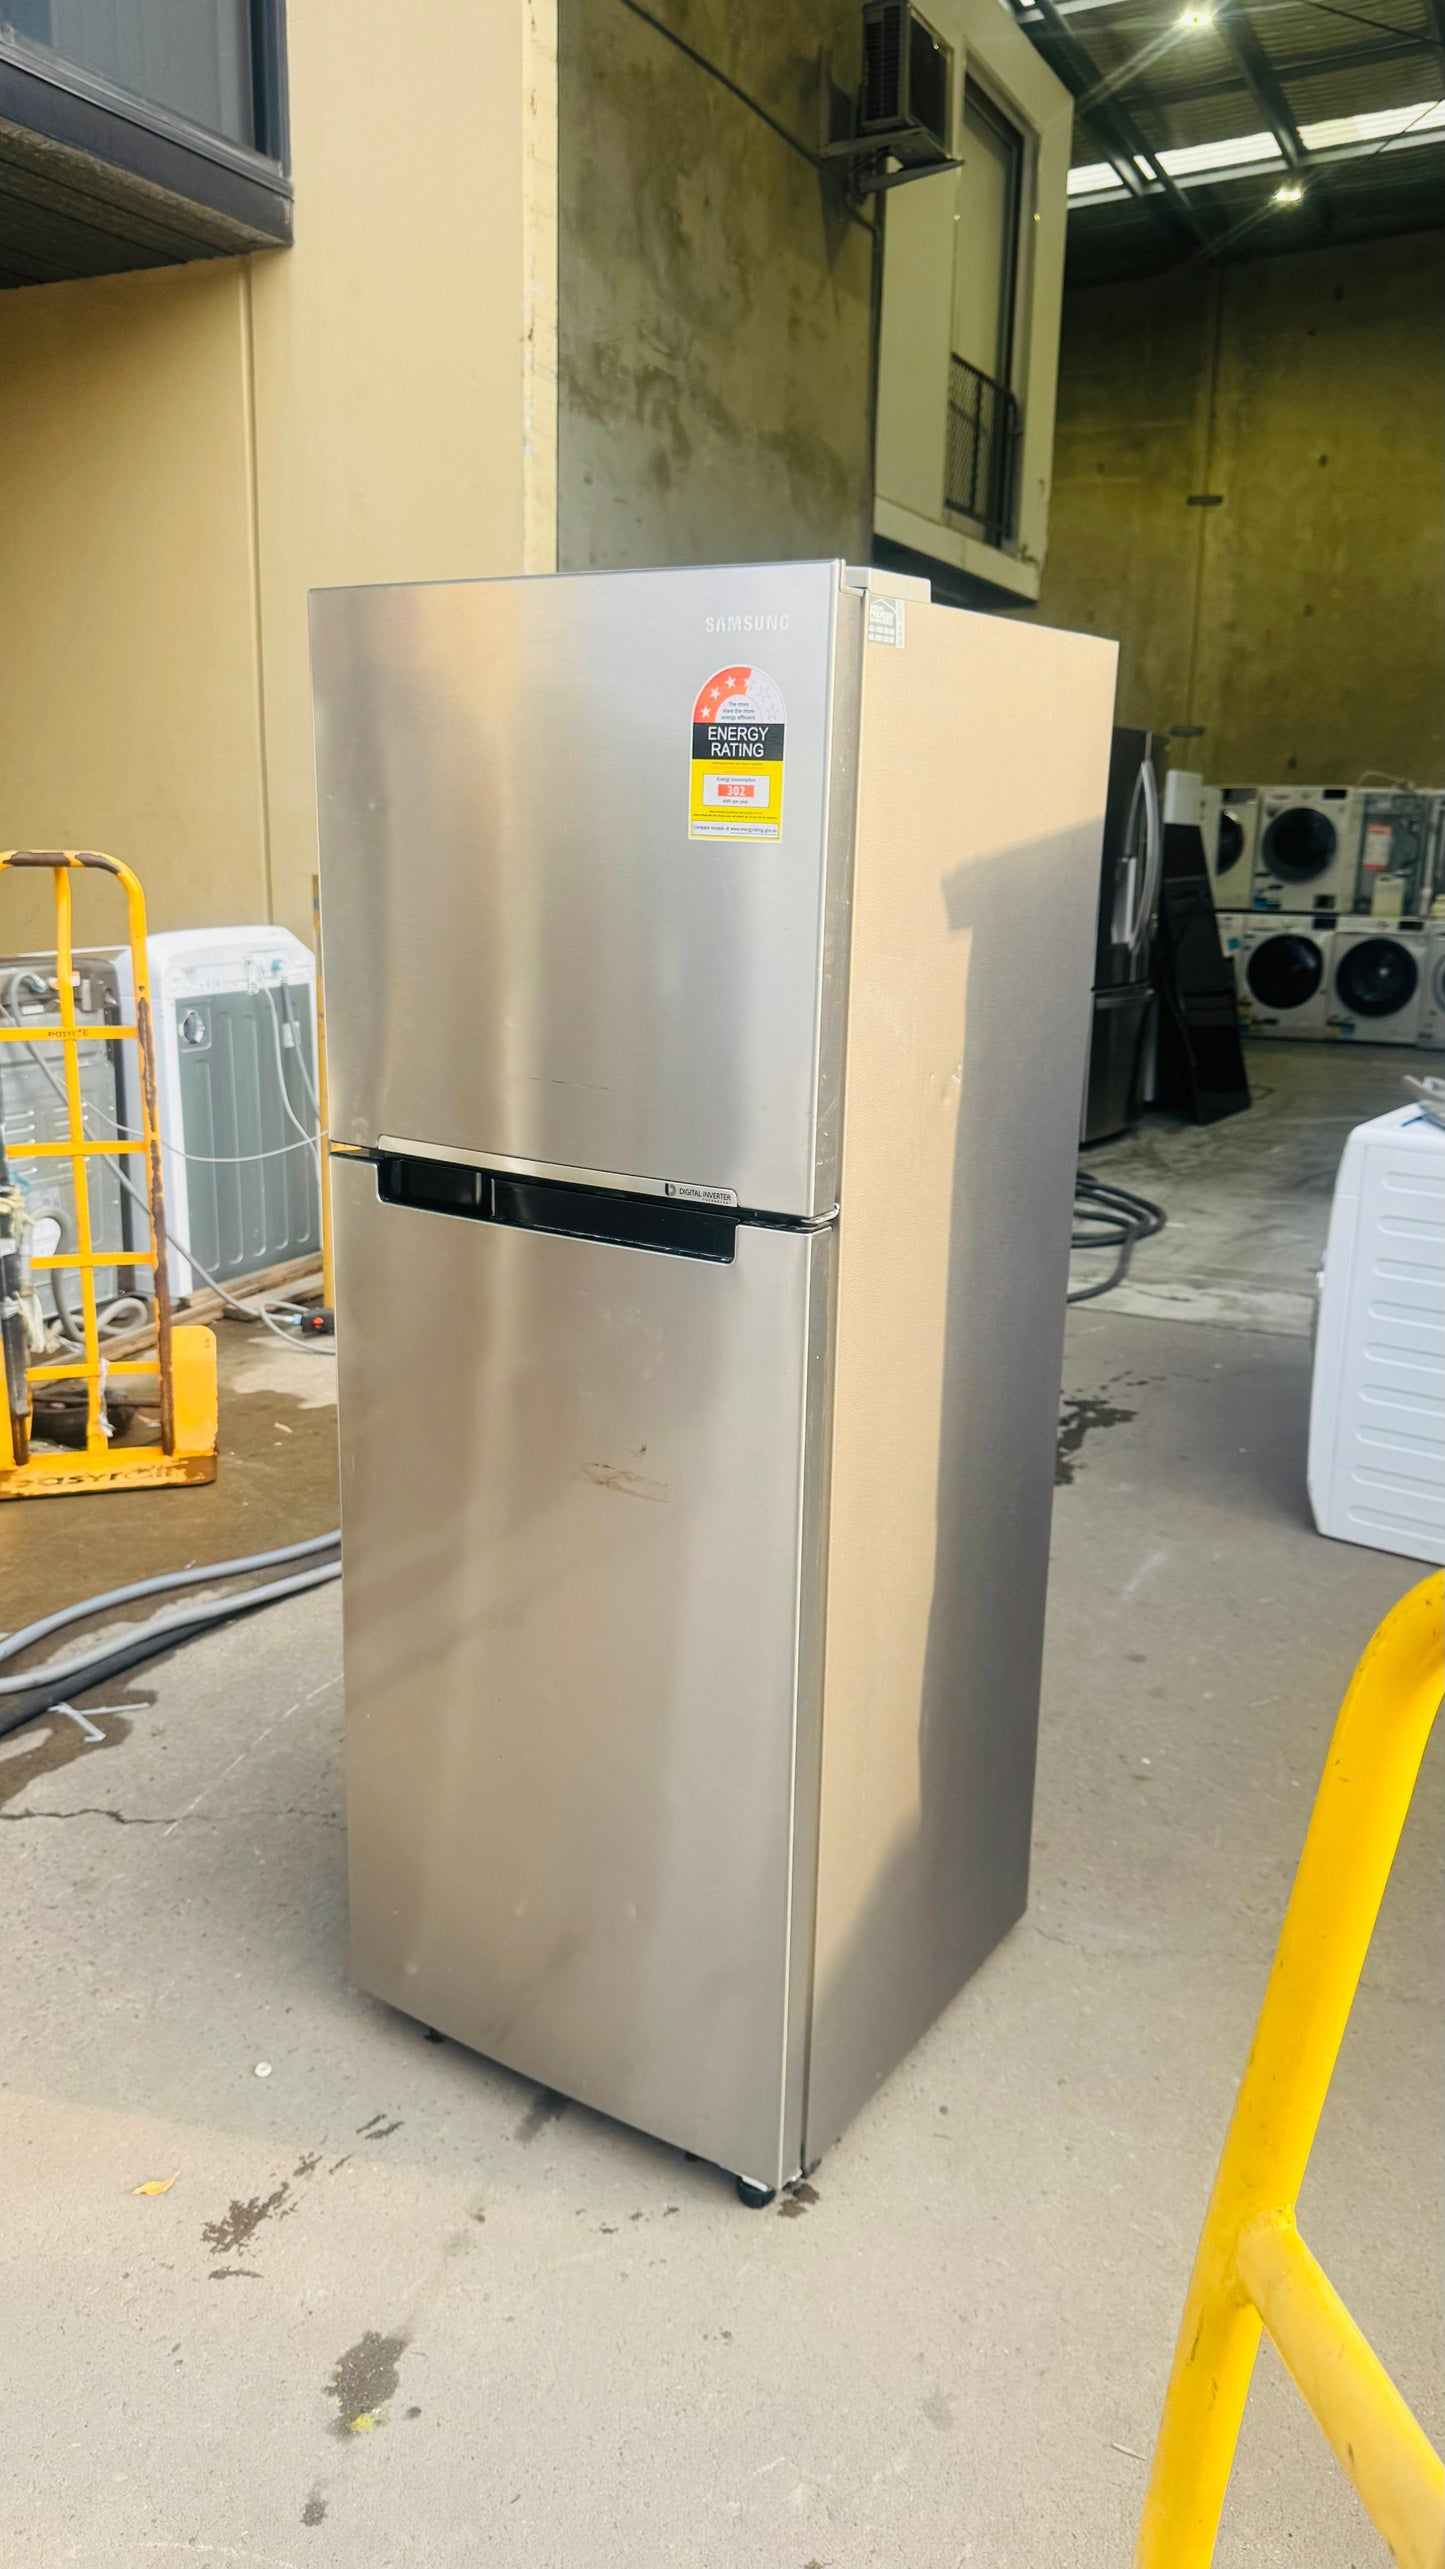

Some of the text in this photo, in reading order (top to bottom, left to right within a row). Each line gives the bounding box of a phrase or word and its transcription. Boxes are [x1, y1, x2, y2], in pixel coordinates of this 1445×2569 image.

[705, 614, 790, 633] SAMSUNG
[708, 726, 769, 742] ENERGY
[711, 742, 764, 758] RATING
[727, 785, 745, 797] 302
[679, 1188, 702, 1197] DIGITAL
[703, 1191, 732, 1201] INVERTER
